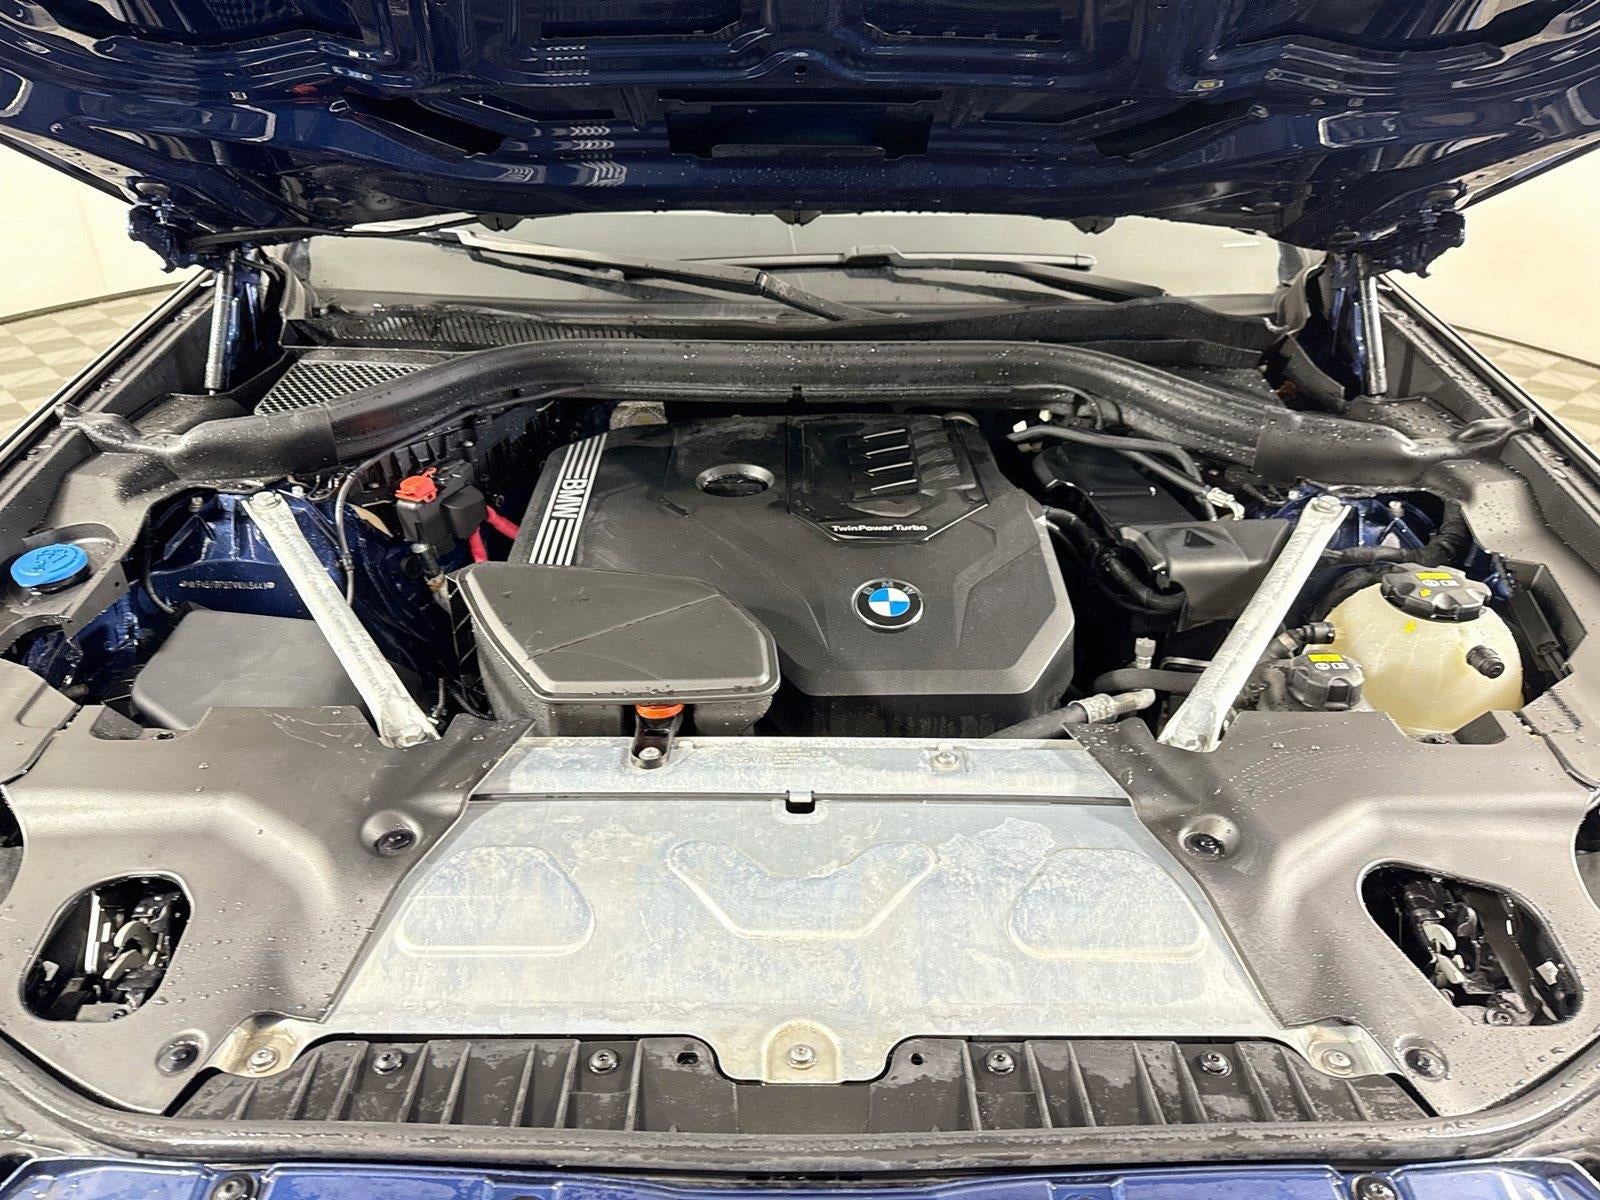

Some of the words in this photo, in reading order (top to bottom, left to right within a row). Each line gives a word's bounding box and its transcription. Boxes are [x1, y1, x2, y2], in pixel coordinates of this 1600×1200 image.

[551, 479, 588, 518] BMW
[831, 524, 893, 532] TwinPower
[862, 581, 917, 595] BMW
